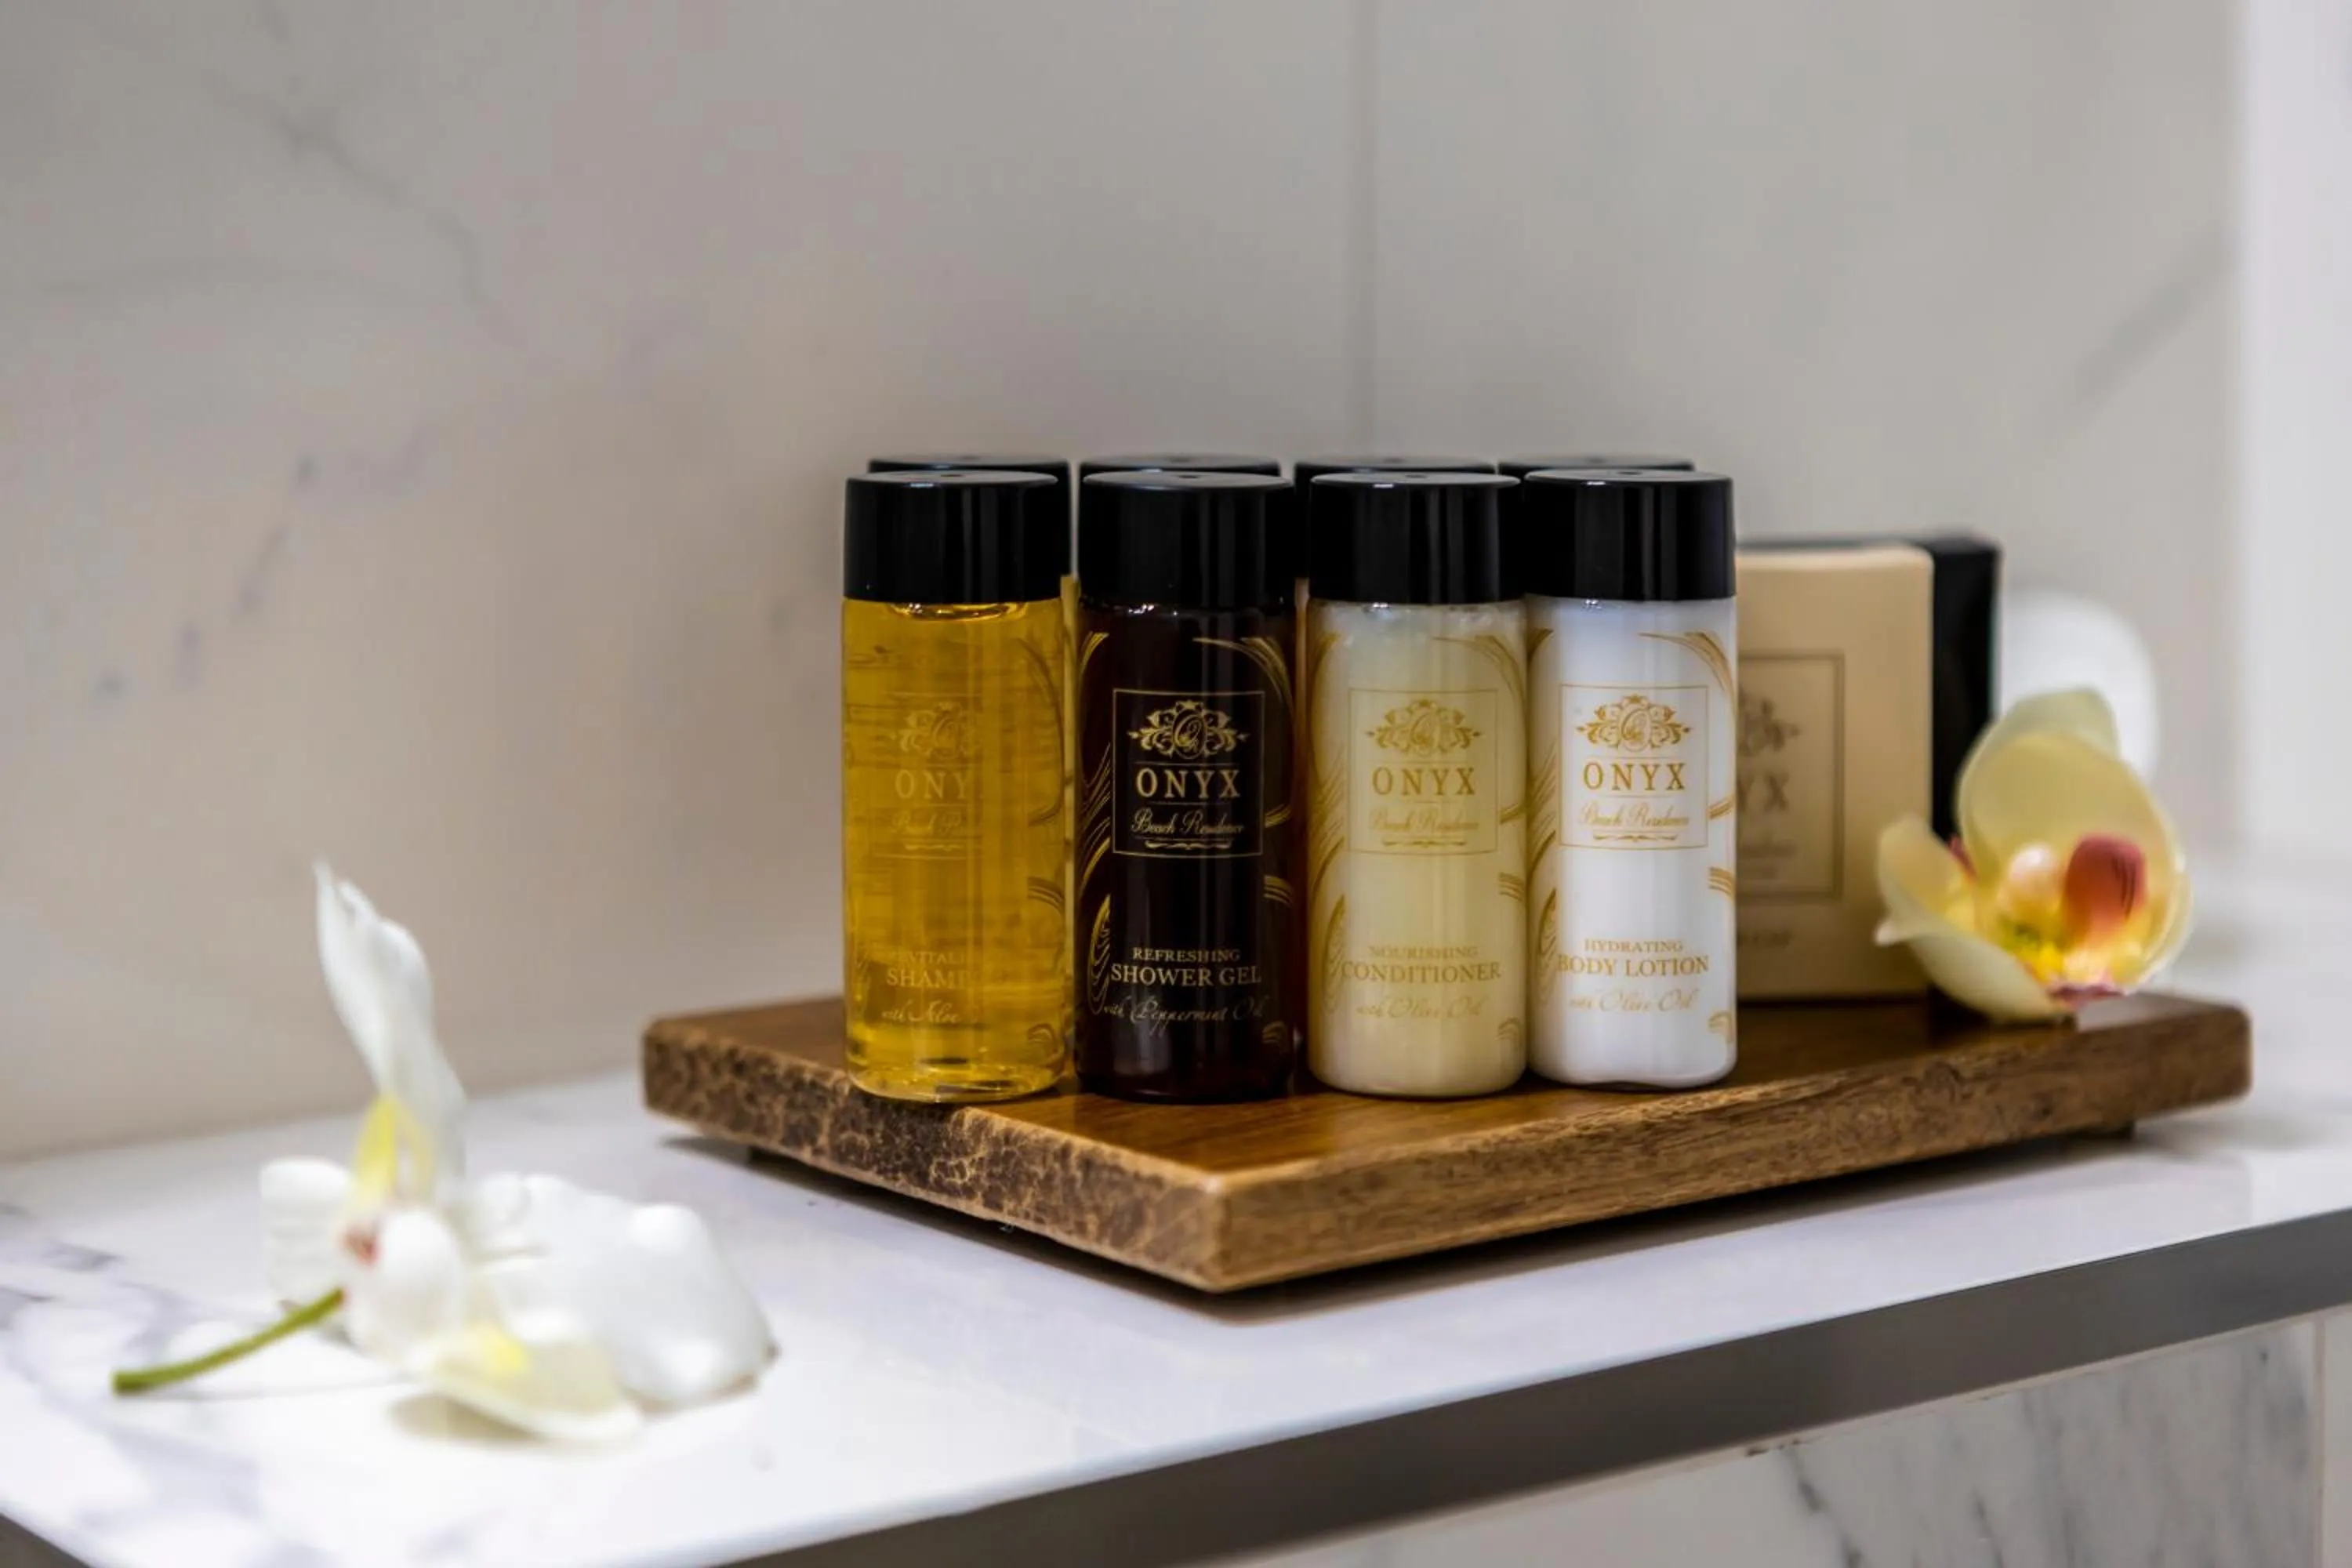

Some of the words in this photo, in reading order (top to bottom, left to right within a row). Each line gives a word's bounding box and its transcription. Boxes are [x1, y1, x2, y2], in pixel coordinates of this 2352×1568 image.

[895, 769, 969, 800] ONY
[1137, 768, 1241, 798] ONYX
[1372, 766, 1475, 797] ONYX
[1583, 761, 1685, 791] ONYX
[1132, 946, 1241, 964] REFRESHING
[1584, 938, 1685, 953] HYDRATING
[1110, 962, 1214, 987] SHOWER
[1218, 966, 1262, 986] GEL
[1341, 960, 1502, 984] CONDITIONER
[1556, 954, 1617, 976] BODY
[1624, 954, 1710, 977] LOTION
[886, 966, 971, 990] SHAMP
